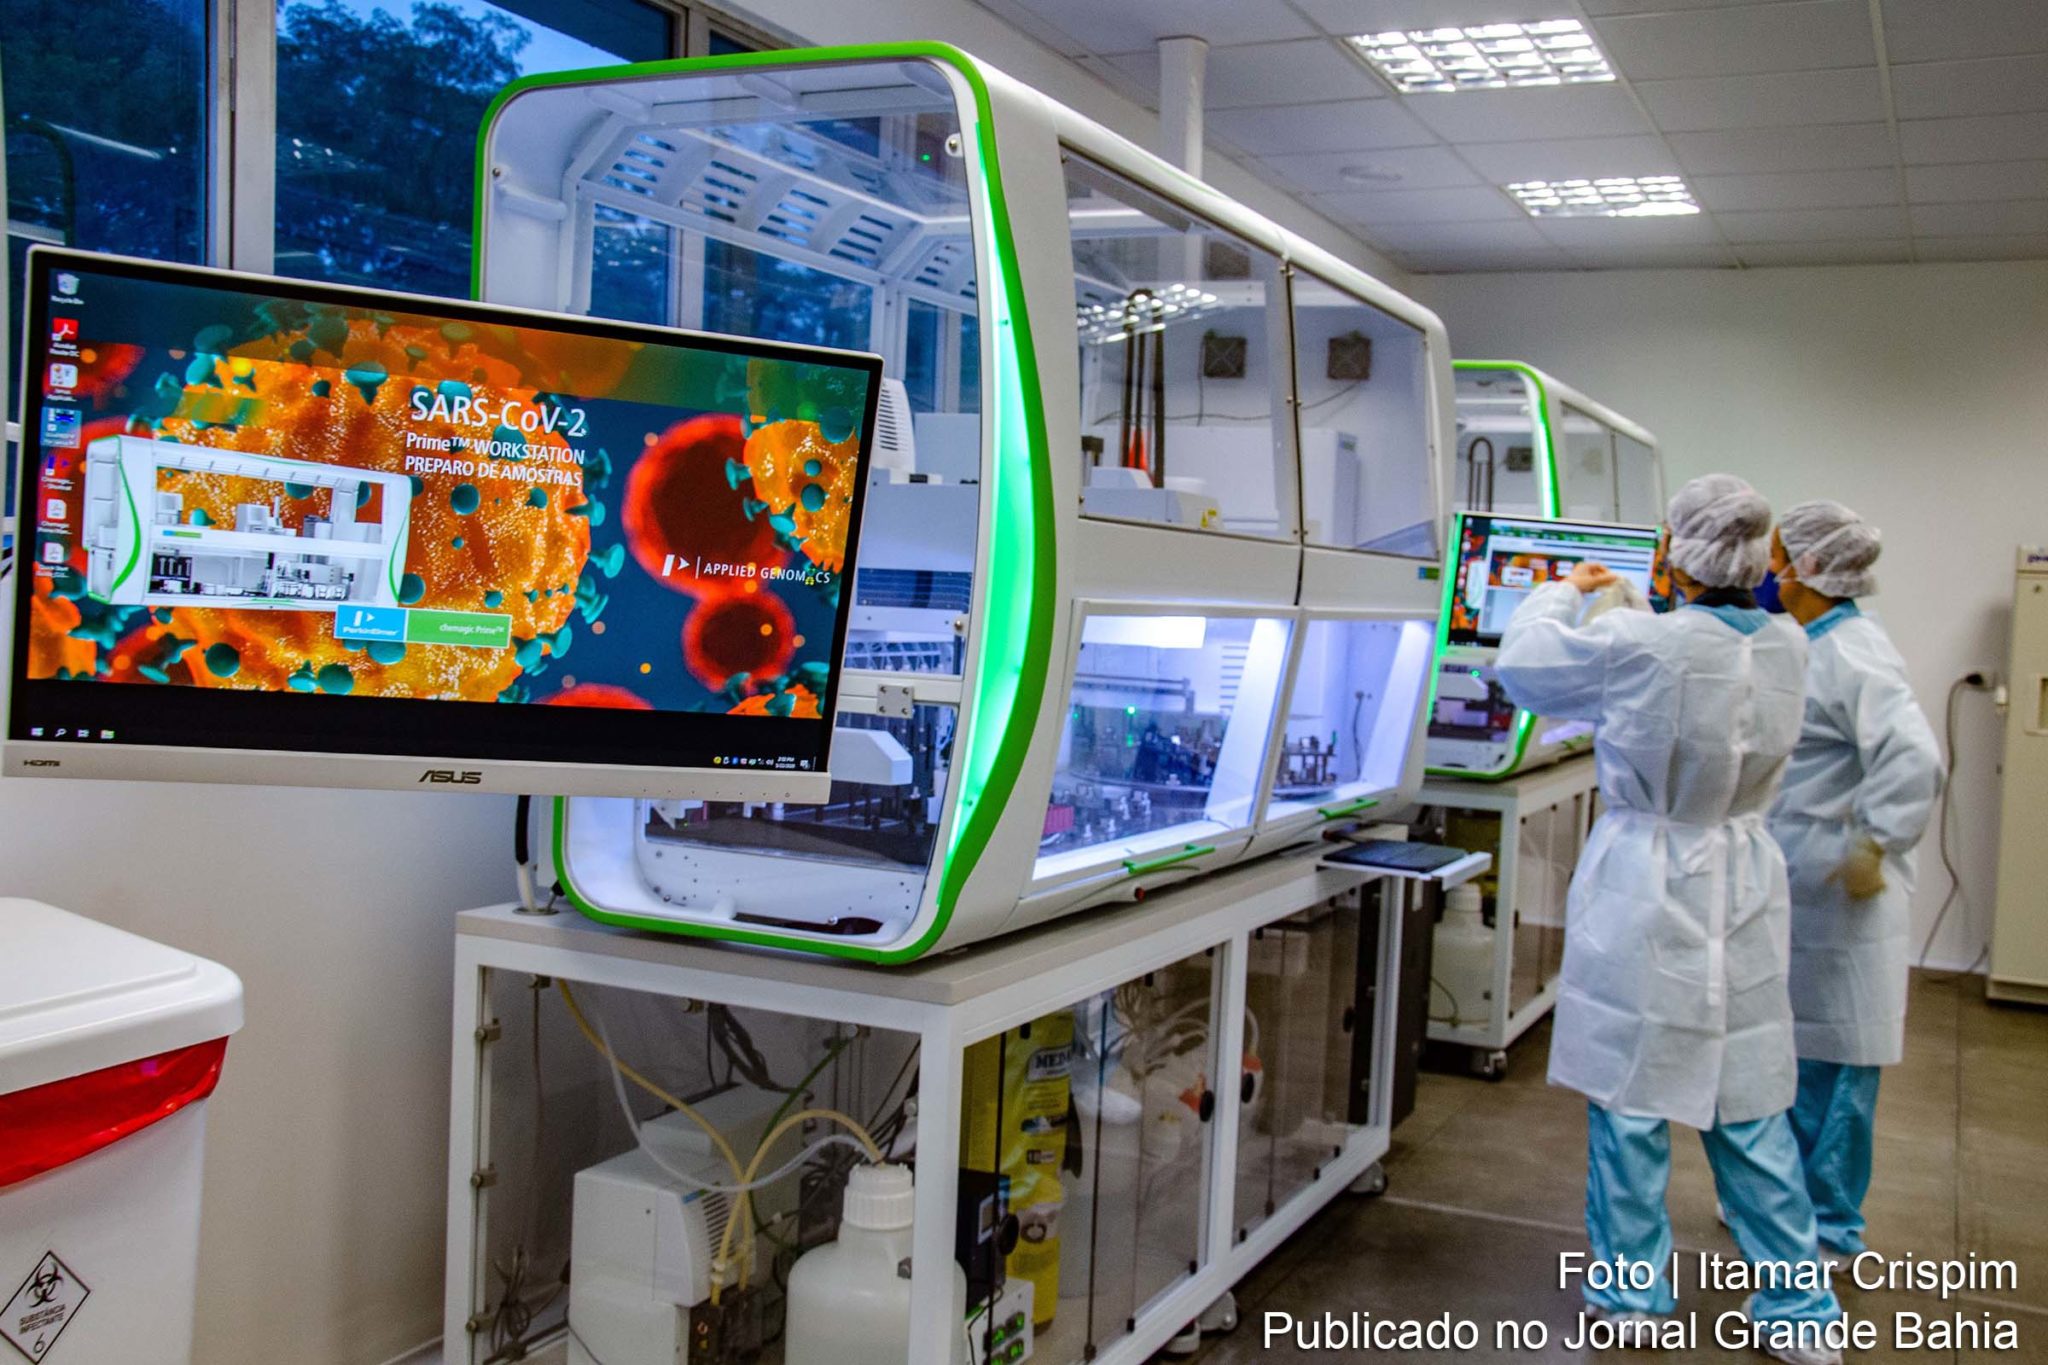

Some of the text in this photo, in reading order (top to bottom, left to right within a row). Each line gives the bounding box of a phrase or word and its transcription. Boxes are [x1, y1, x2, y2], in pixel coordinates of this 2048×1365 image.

[410, 391, 586, 438] SARS-CoV-2
[473, 439, 585, 465] WORKSTATION
[405, 455, 583, 487] PREPARO DE AMOSTRAS
[703, 562, 756, 578] APPLIED
[418, 769, 482, 784] ASUS
[33, 1332, 45, 1354] 6
